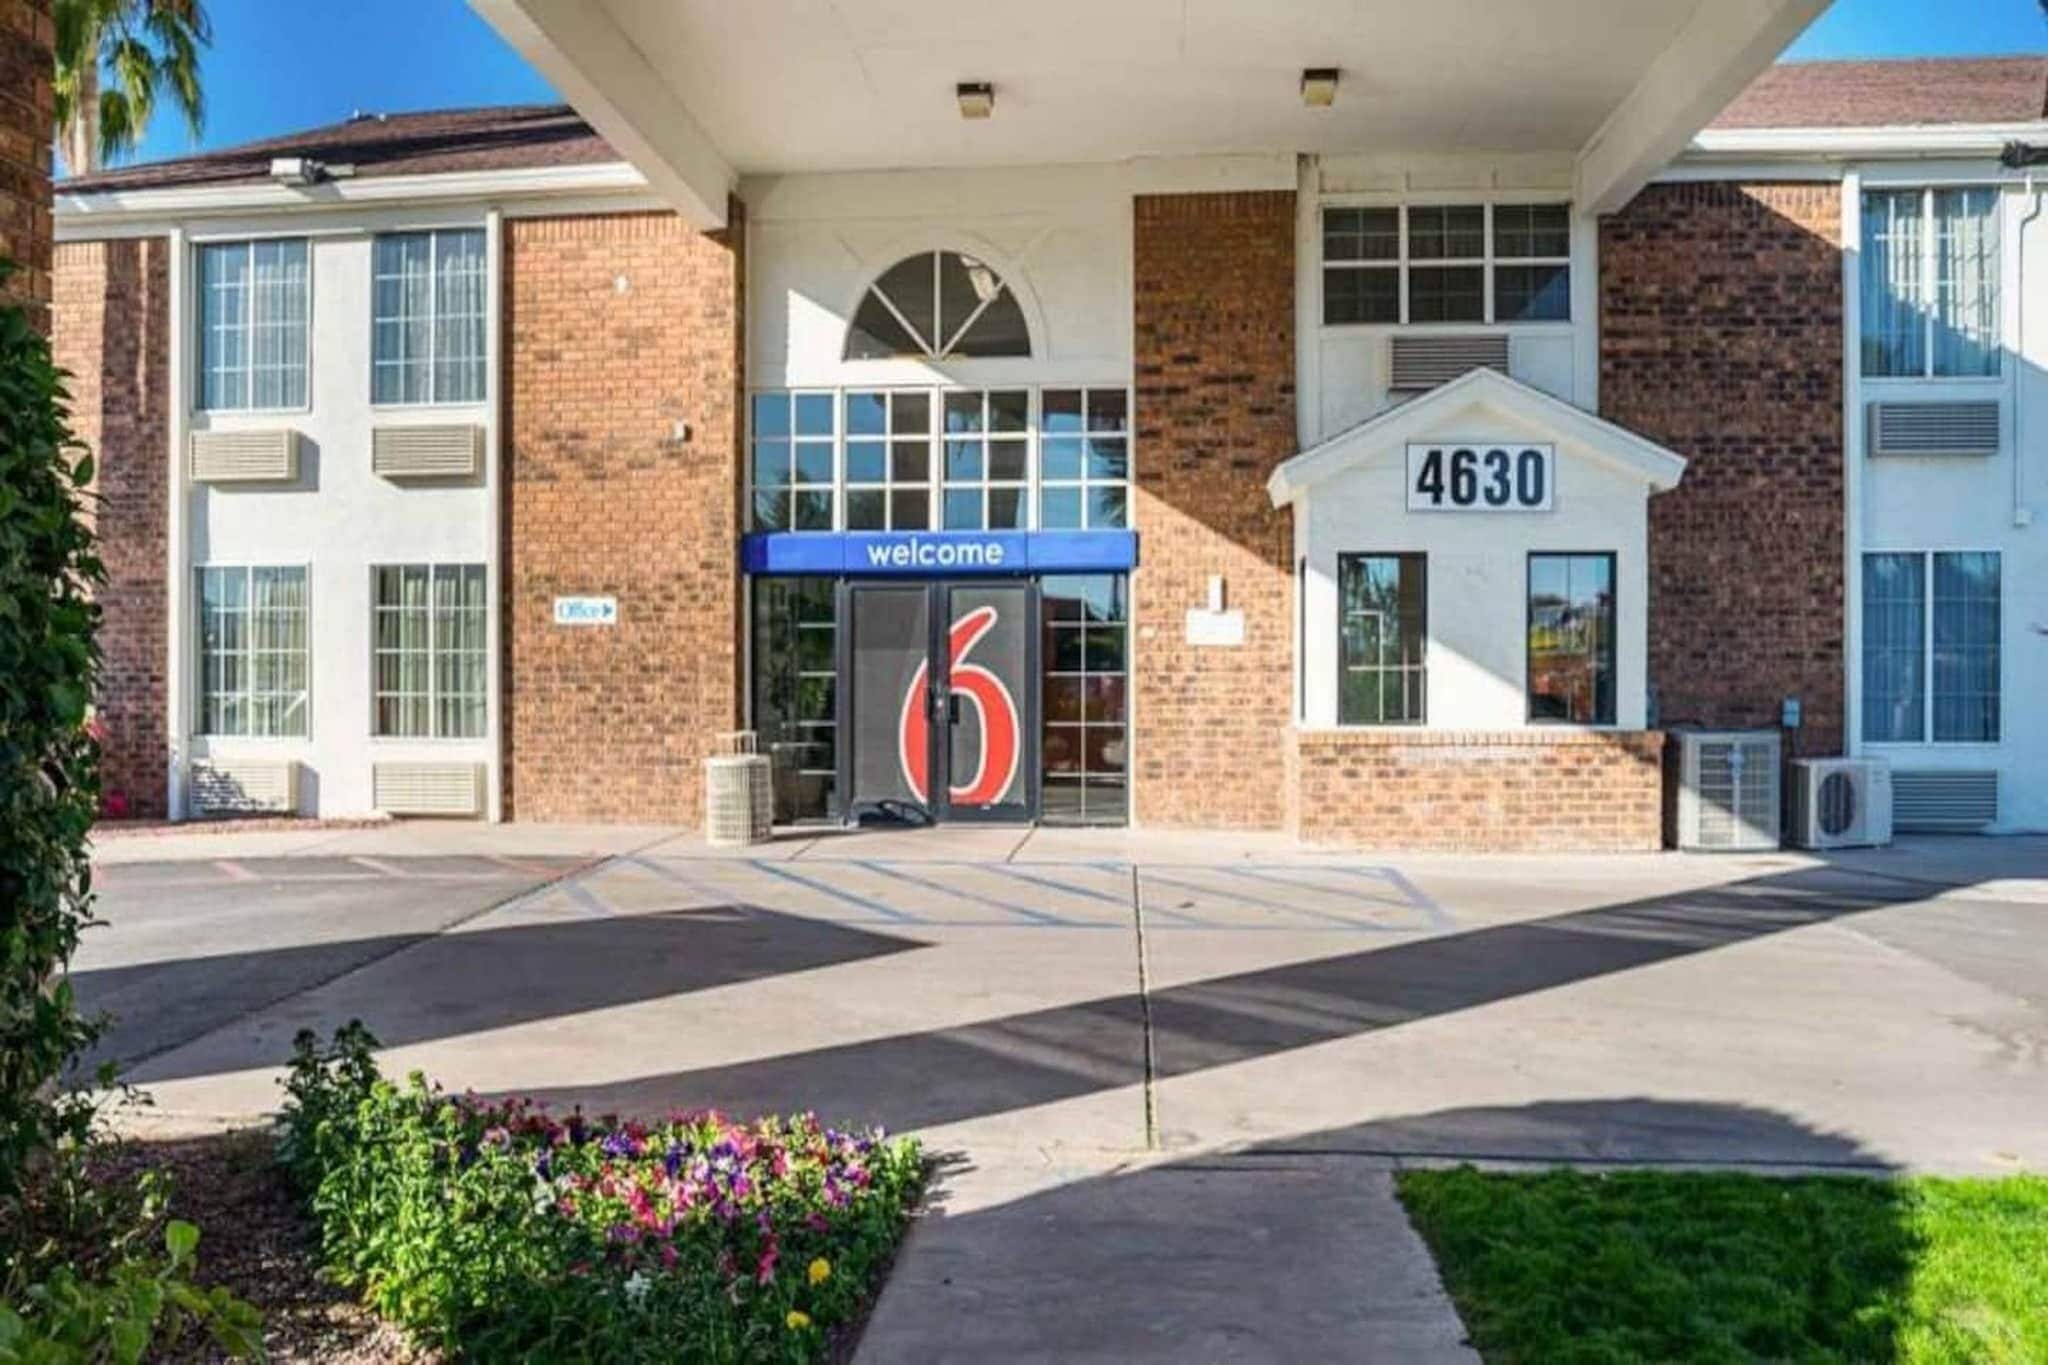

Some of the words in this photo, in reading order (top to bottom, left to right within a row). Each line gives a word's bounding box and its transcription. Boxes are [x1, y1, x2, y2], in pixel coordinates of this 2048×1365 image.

[1416, 449, 1545, 506] 4630
[867, 537, 1004, 566] welcome
[900, 606, 1020, 805] 6
